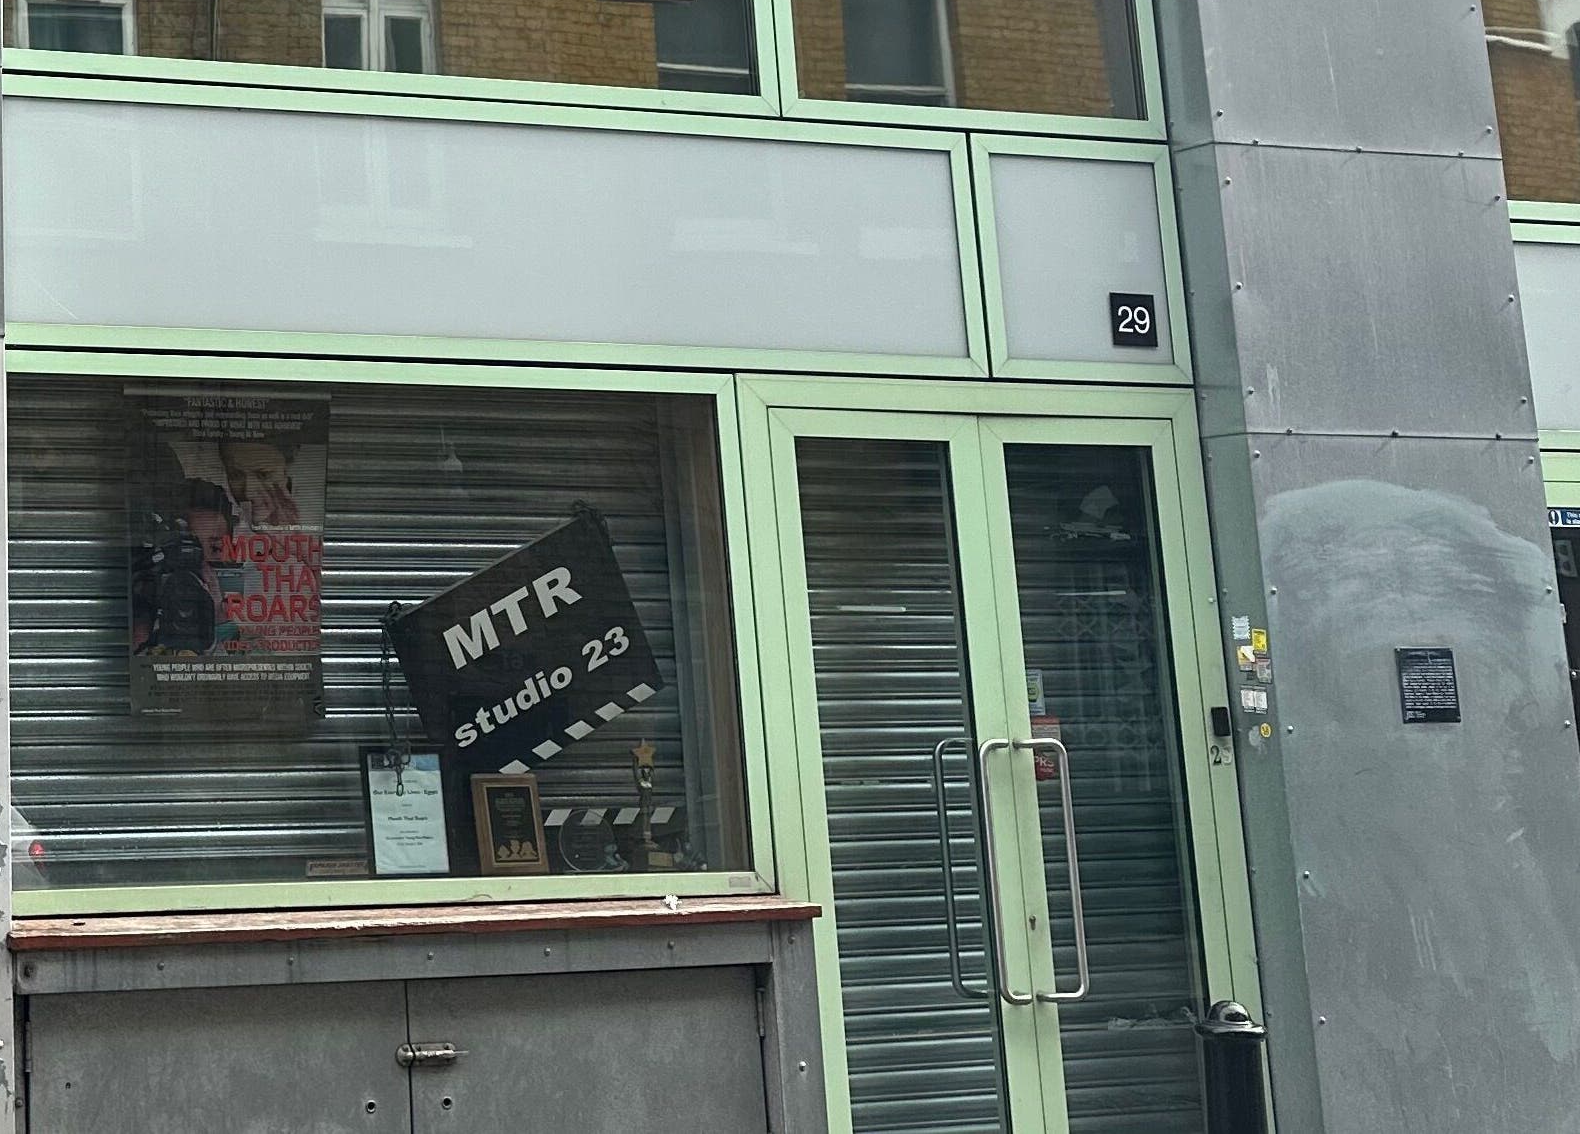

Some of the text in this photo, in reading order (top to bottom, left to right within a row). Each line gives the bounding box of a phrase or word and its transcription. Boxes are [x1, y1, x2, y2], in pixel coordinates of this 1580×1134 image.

[1118, 306, 1150, 333] 29
[221, 533, 321, 562] MOUTH
[442, 566, 584, 670] MTR
[454, 626, 630, 748] studio 23
